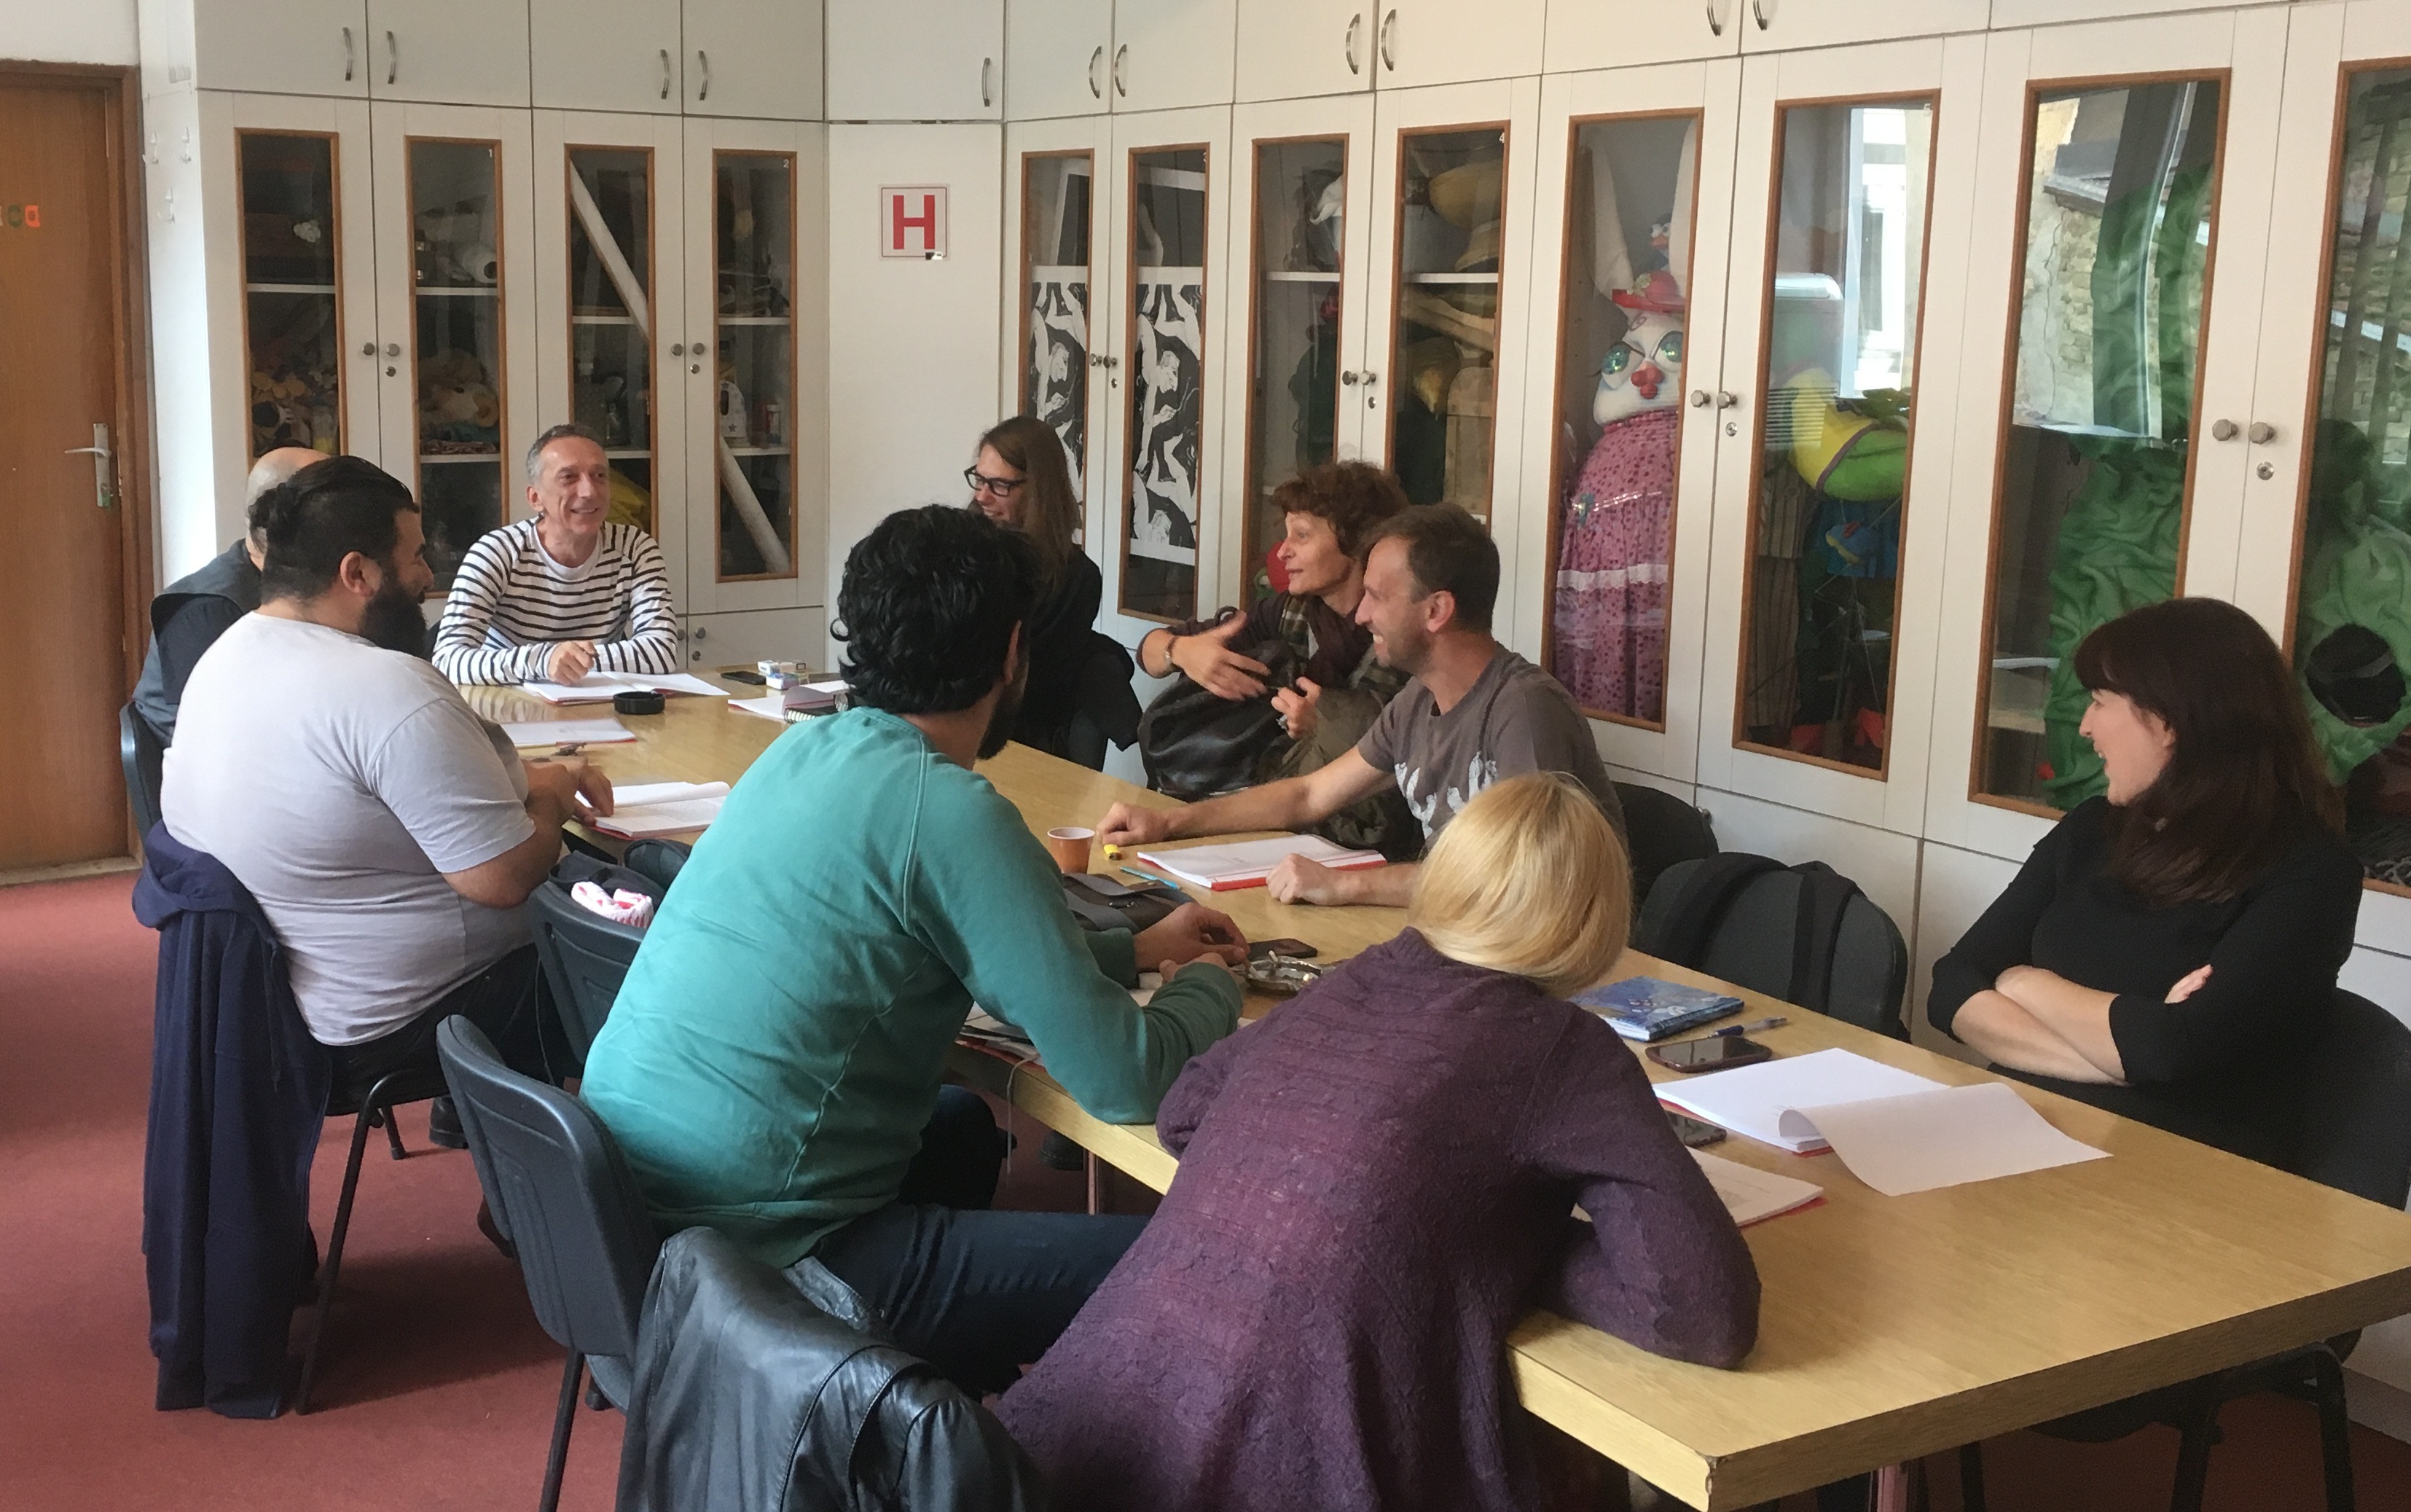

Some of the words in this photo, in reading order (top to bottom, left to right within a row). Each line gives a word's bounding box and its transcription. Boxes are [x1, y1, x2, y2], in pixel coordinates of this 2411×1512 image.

[1499, 132, 1505, 144] 4
[488, 149, 493, 157] 1
[783, 158, 789, 168] 2
[893, 195, 936, 249] H
